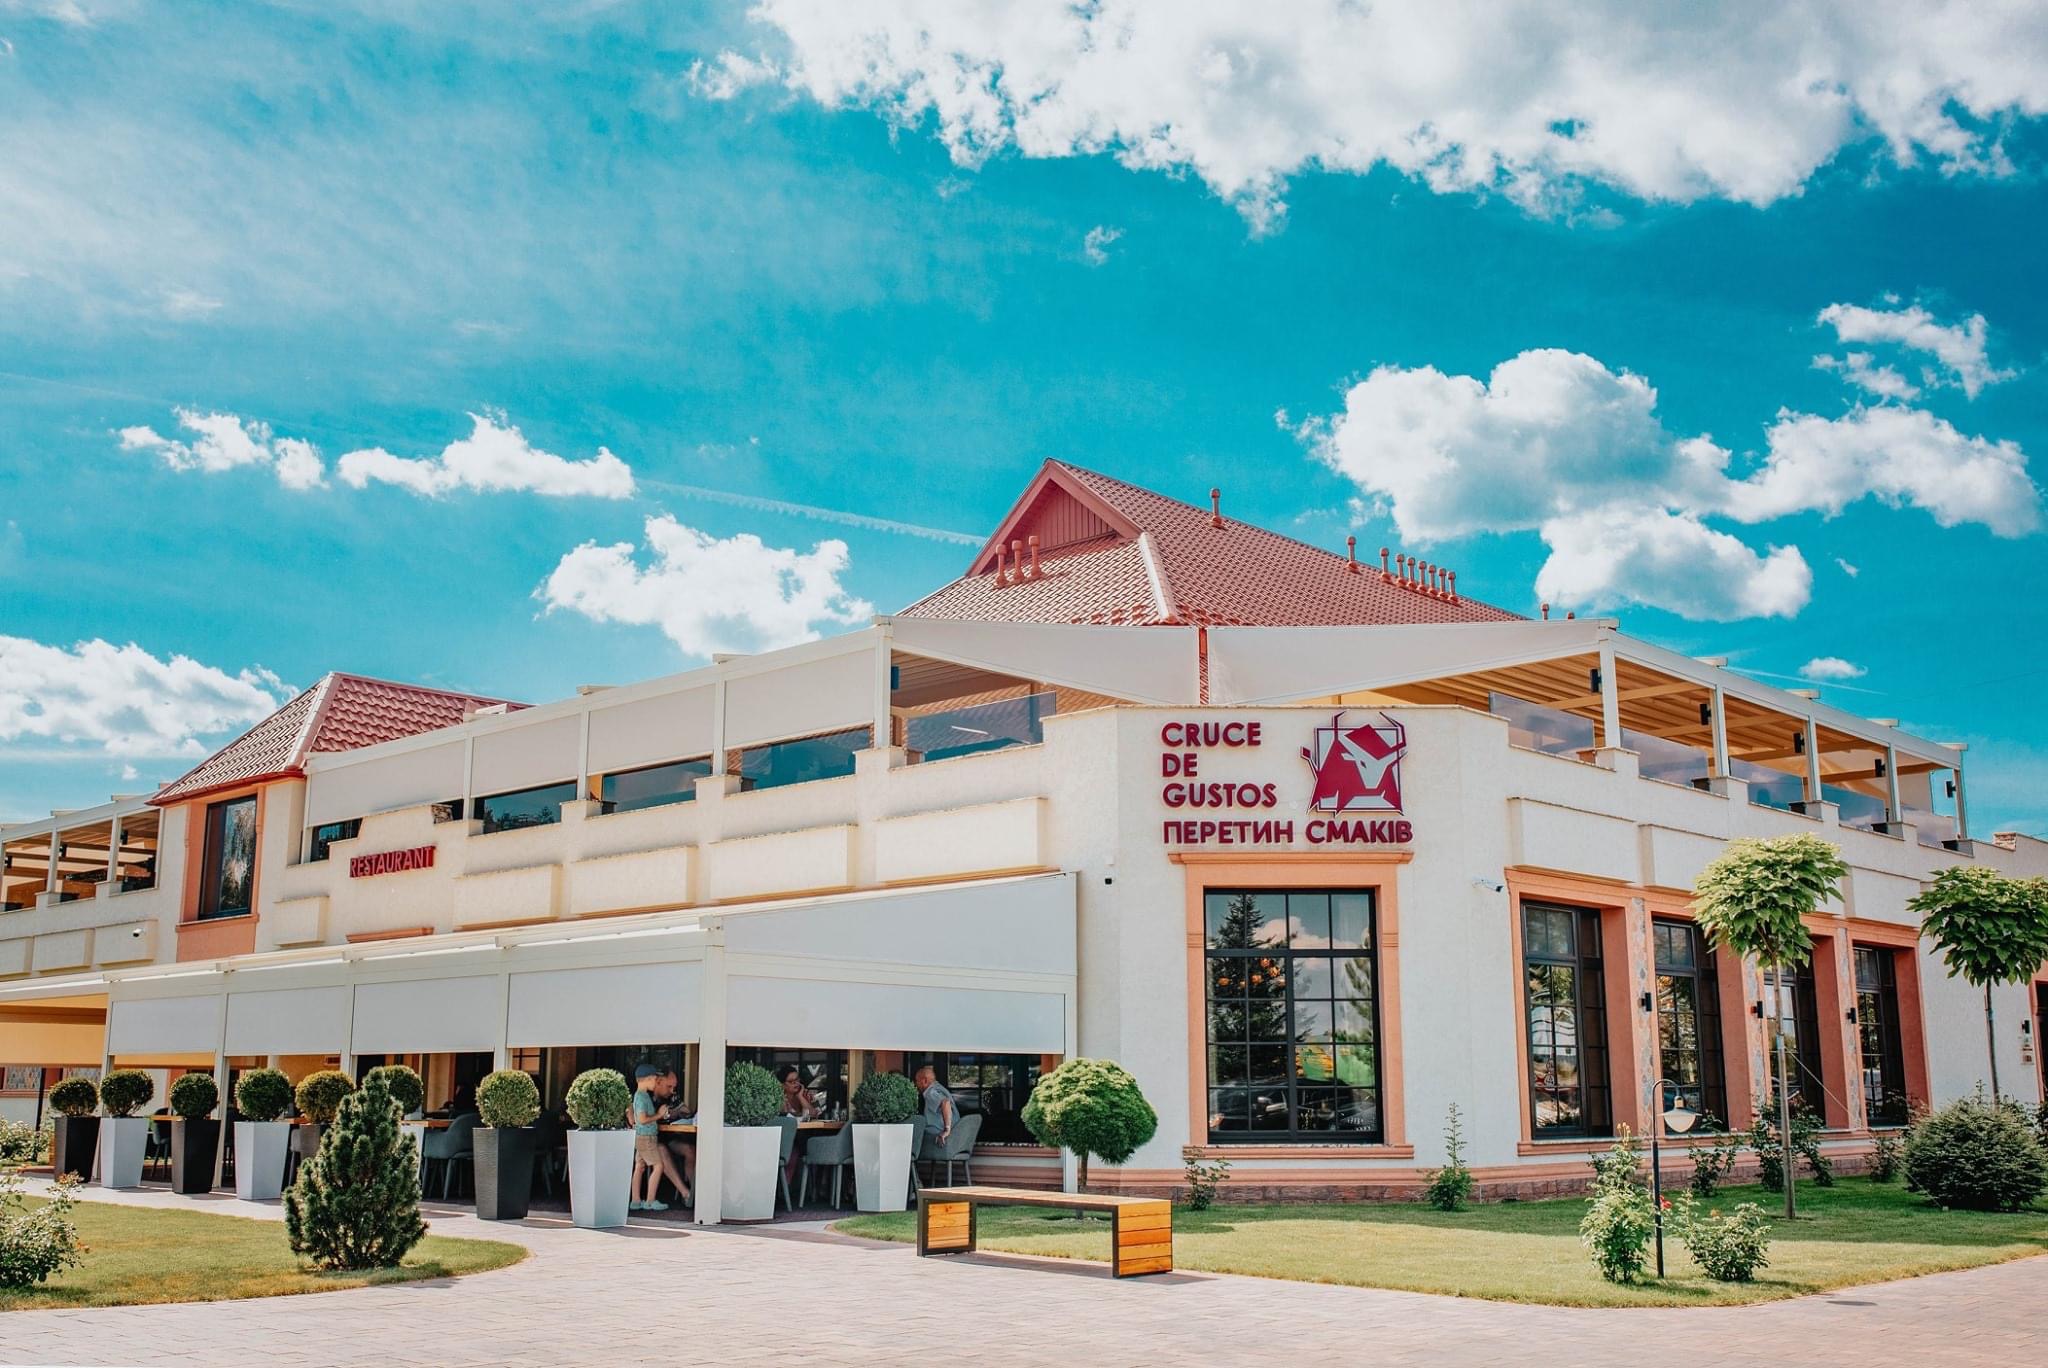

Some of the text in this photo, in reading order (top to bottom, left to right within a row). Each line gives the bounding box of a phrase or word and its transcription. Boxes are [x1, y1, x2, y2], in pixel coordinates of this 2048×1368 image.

[1161, 721, 1261, 748] CRUCE
[1161, 752, 1197, 778] DE
[1162, 782, 1277, 808] GUSTOS
[1163, 819, 1413, 844] ПЕРЕТИН СМАКІВ
[350, 845, 436, 878] RESTAURANT
